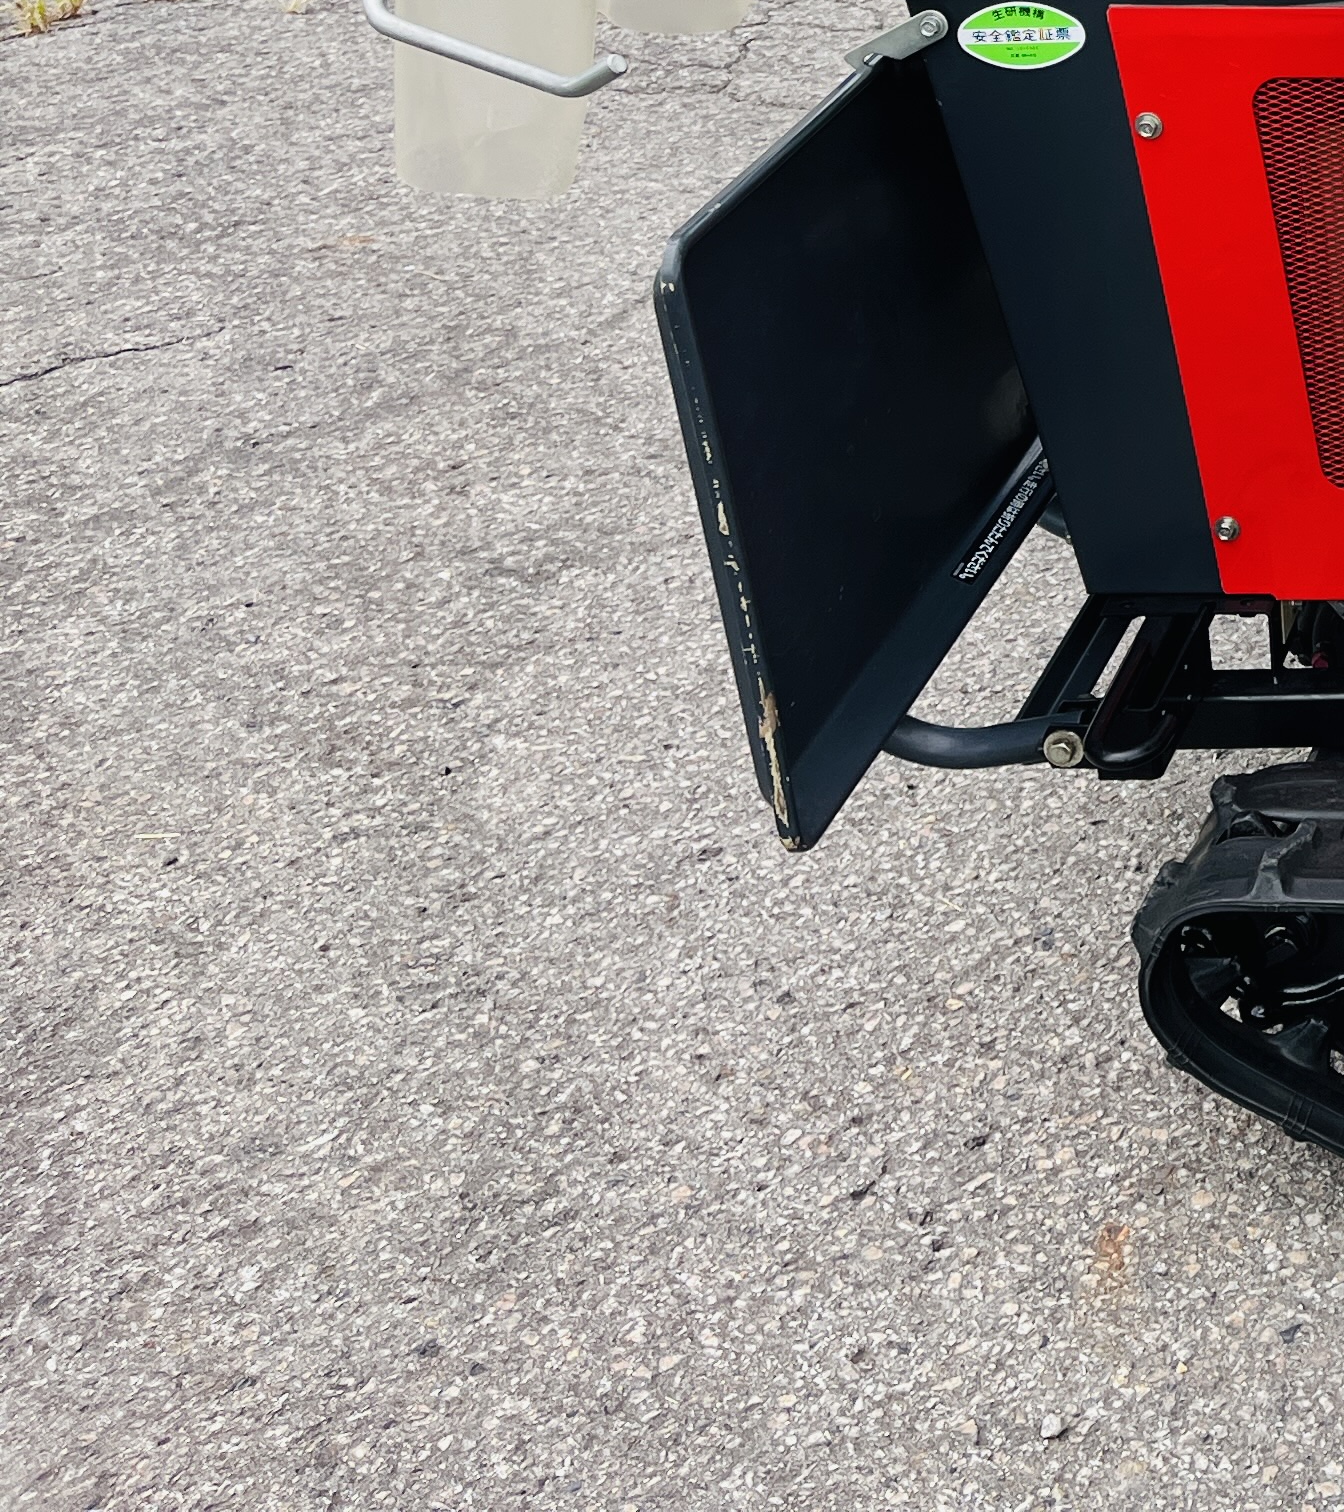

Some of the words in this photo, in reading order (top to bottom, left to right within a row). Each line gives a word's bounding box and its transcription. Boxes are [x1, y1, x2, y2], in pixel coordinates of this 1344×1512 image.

[992, 6, 1047, 21] 生研機構
[972, 27, 1071, 43] 安全鑑定証票
